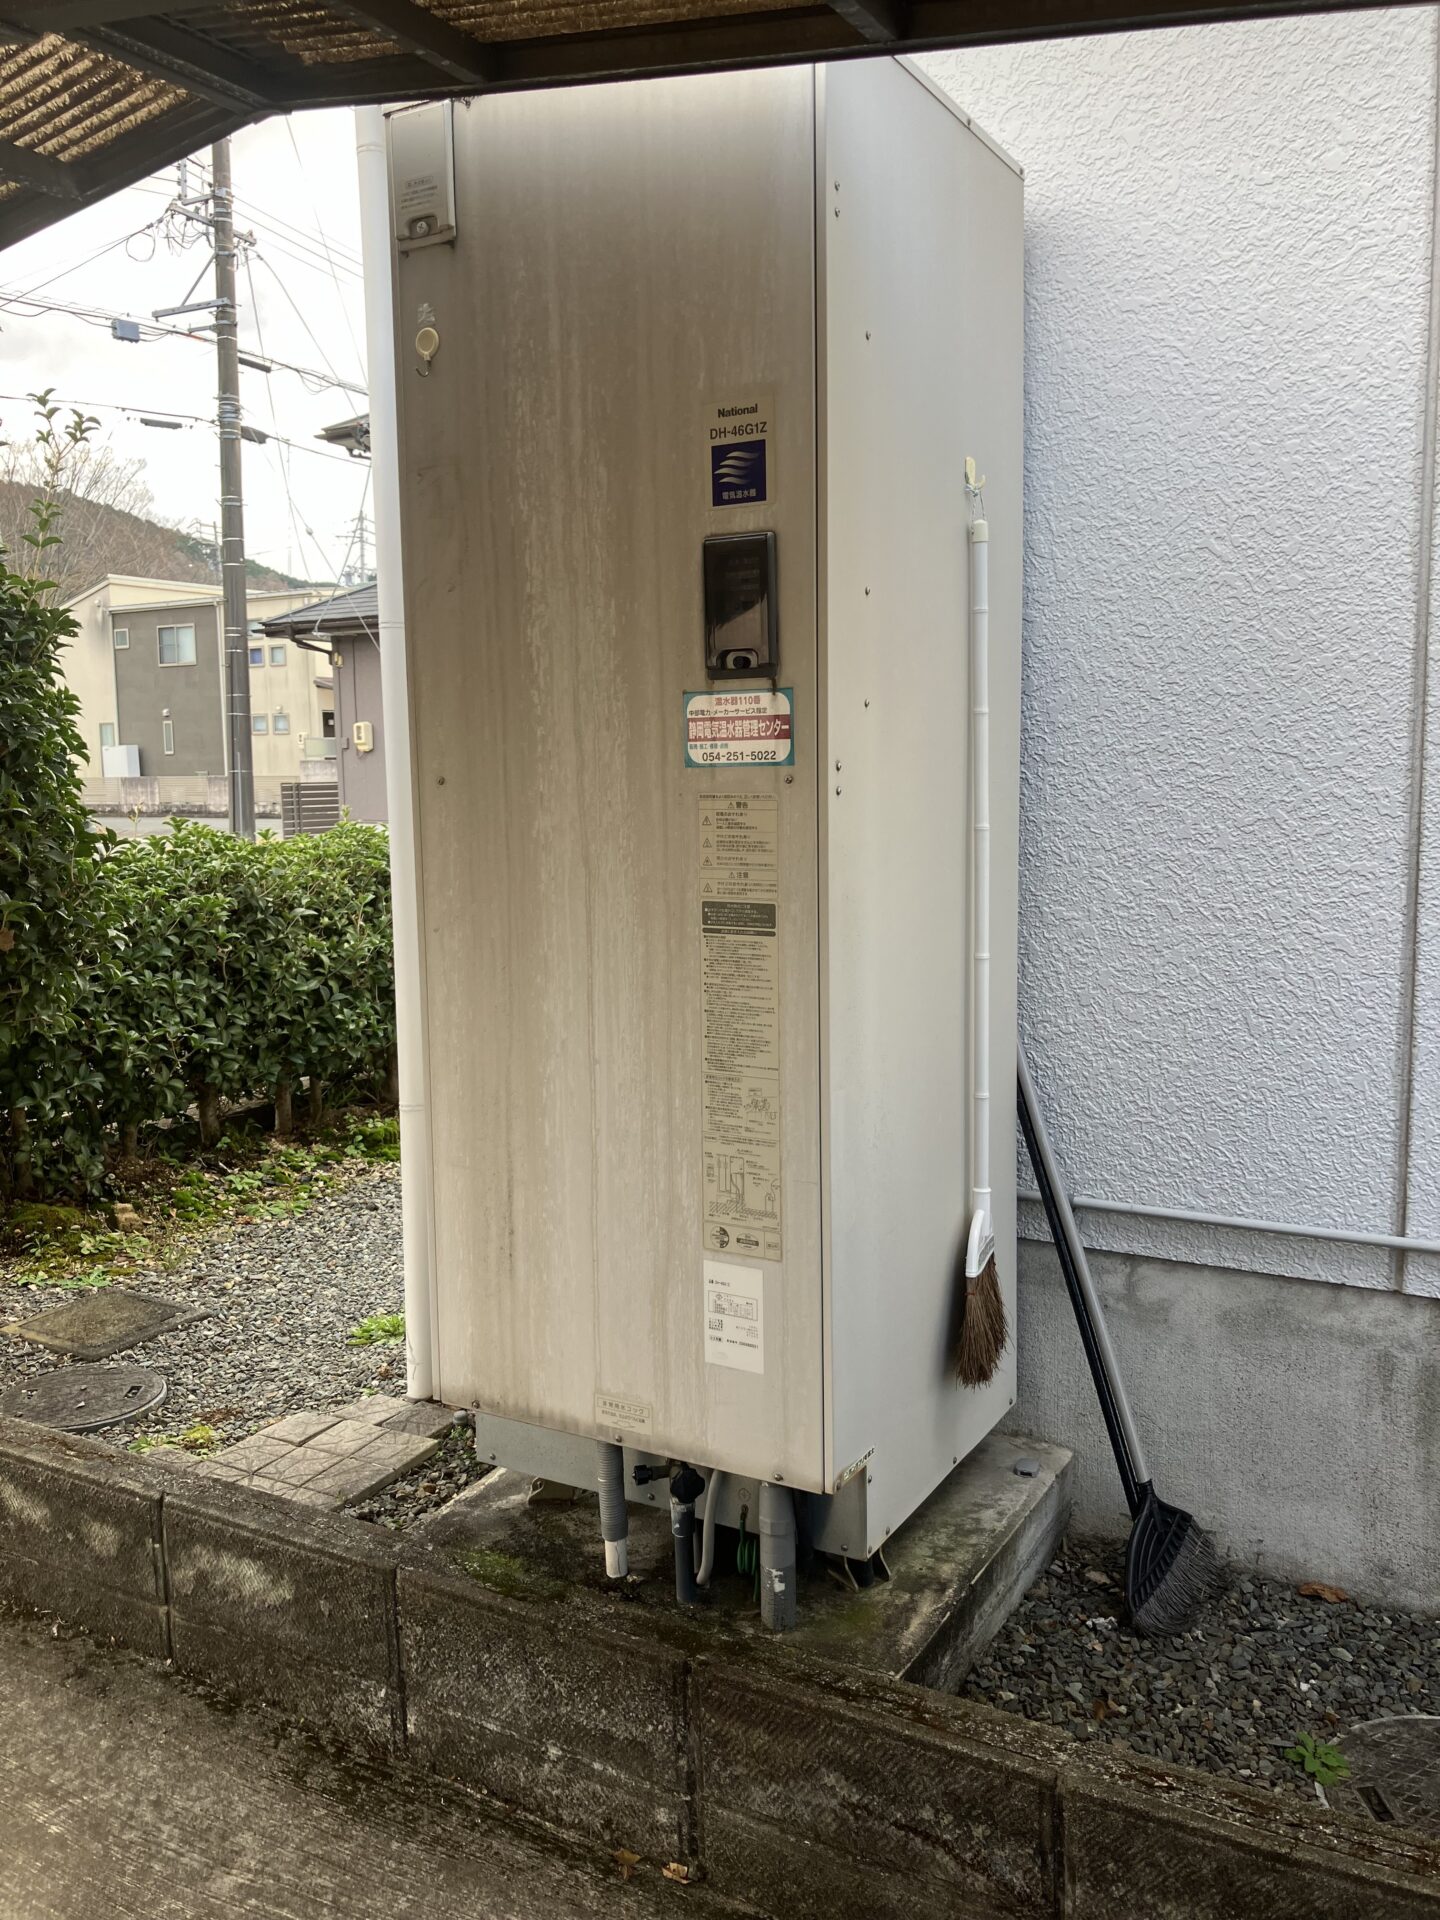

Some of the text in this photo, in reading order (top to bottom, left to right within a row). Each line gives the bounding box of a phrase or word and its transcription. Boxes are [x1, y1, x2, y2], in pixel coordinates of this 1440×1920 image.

[718, 403, 758, 418] National
[710, 421, 767, 440] DH-46G1Z
[715, 695, 761, 706] 温水器110番
[688, 719, 790, 740] 静岡電気温水器管理センター
[702, 750, 777, 762] 054-251-5022
